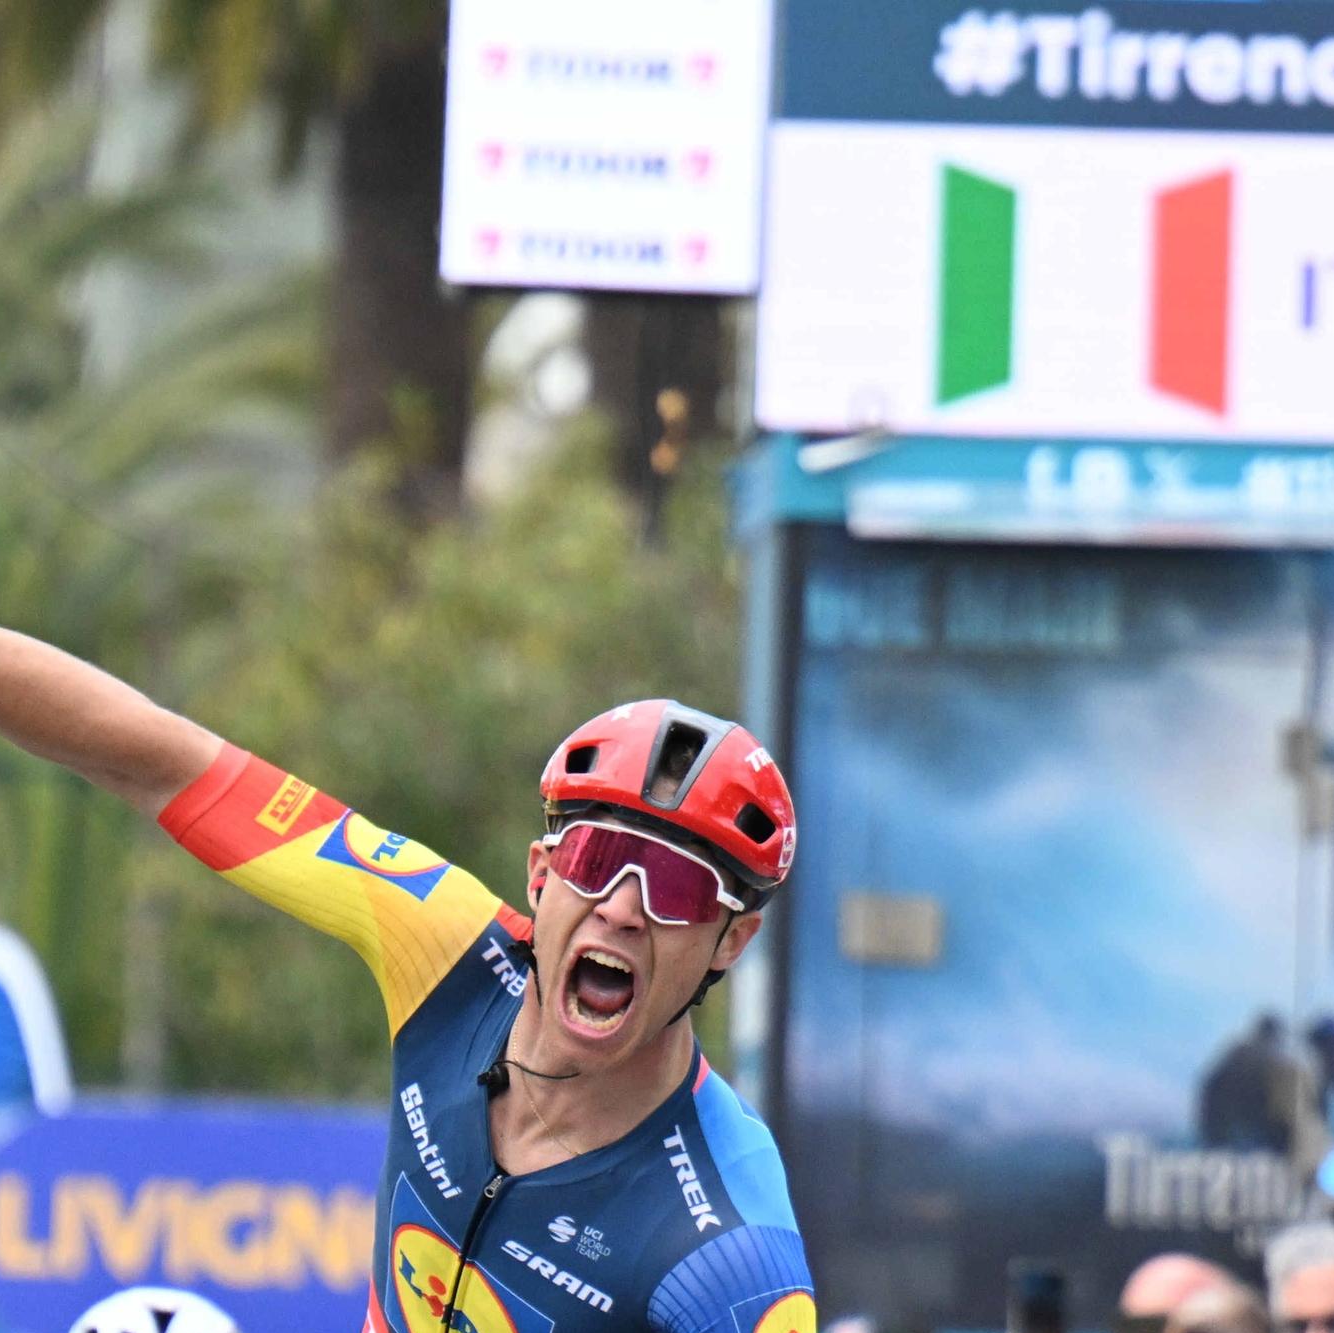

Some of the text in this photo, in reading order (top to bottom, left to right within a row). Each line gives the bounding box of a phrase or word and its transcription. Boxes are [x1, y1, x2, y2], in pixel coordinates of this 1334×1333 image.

[400, 1082, 463, 1201] Santini
[662, 1125, 723, 1233] TREK
[575, 1243, 600, 1262] TEAM
[579, 1235, 611, 1257] WORLD
[583, 1225, 604, 1242] UCI
[500, 1240, 613, 1313] SRAM
